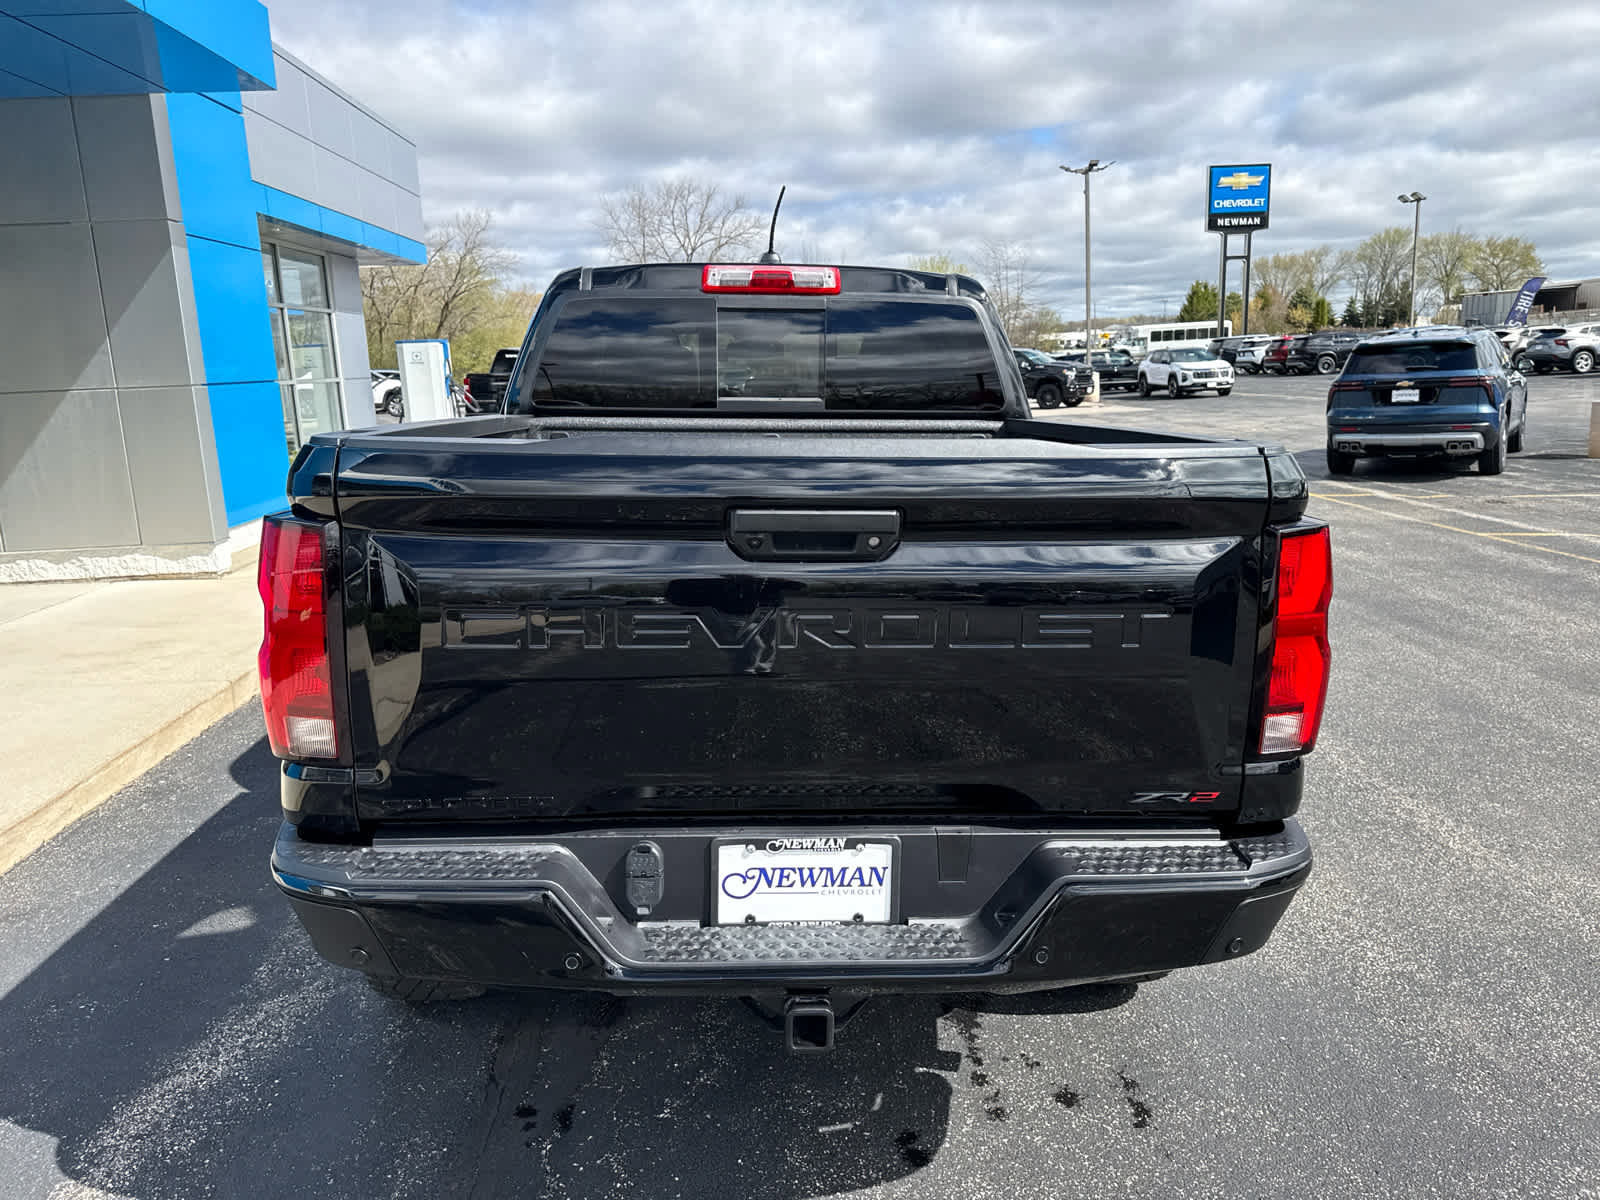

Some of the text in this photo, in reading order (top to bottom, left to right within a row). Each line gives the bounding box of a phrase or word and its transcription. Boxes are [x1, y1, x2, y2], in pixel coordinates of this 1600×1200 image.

[1214, 198, 1266, 208] CHEVROLET
[1217, 216, 1261, 226] NEWMAN
[1515, 290, 1536, 314] TIRE
[440, 606, 1171, 649] CHEVROLET
[1129, 791, 1221, 803] ZR2
[766, 838, 847, 855] NEWMAN
[722, 866, 888, 899] NEWMAN
[820, 888, 883, 896] CHEVROLET
